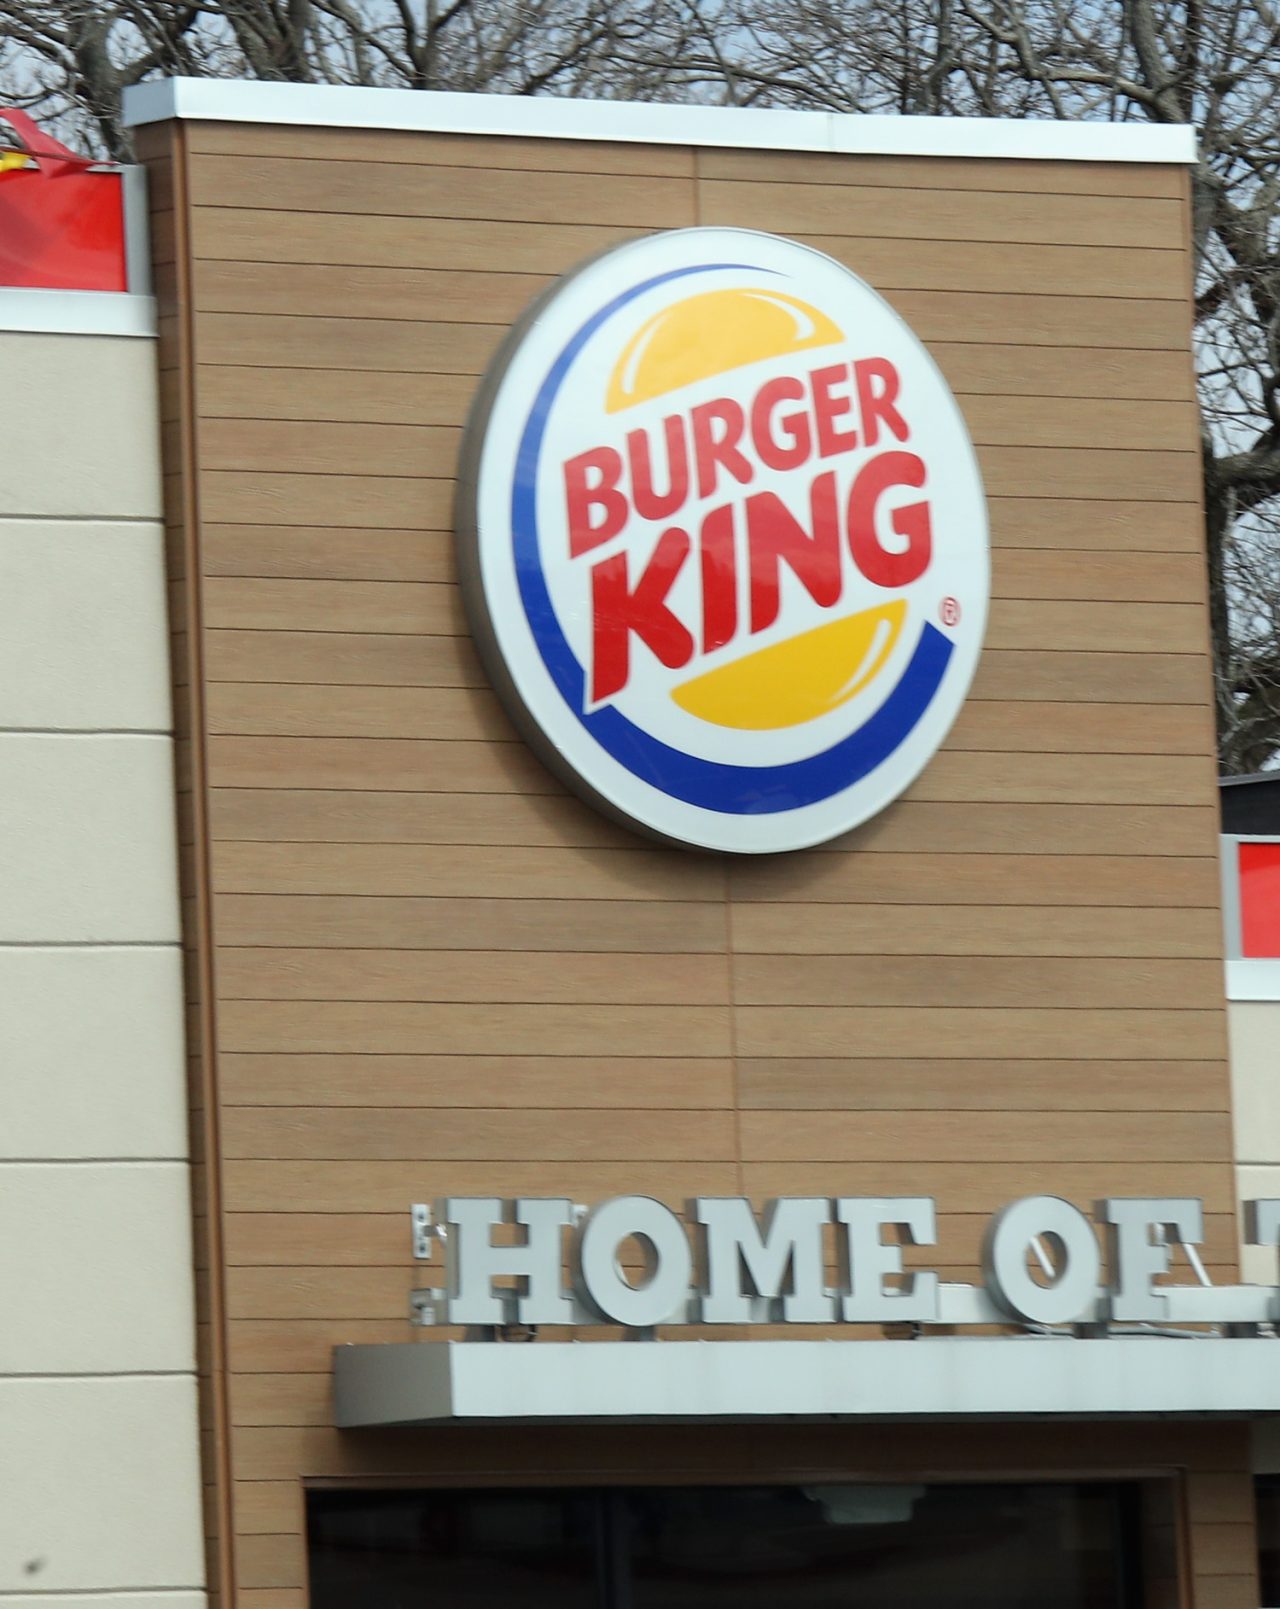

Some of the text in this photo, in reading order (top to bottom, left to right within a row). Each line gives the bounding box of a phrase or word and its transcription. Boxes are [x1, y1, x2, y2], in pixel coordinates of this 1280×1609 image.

[562, 356, 910, 560] BURGER
[589, 450, 931, 704] KING
[446, 1195, 937, 1326] HOME
[988, 1195, 1203, 1325] OF
